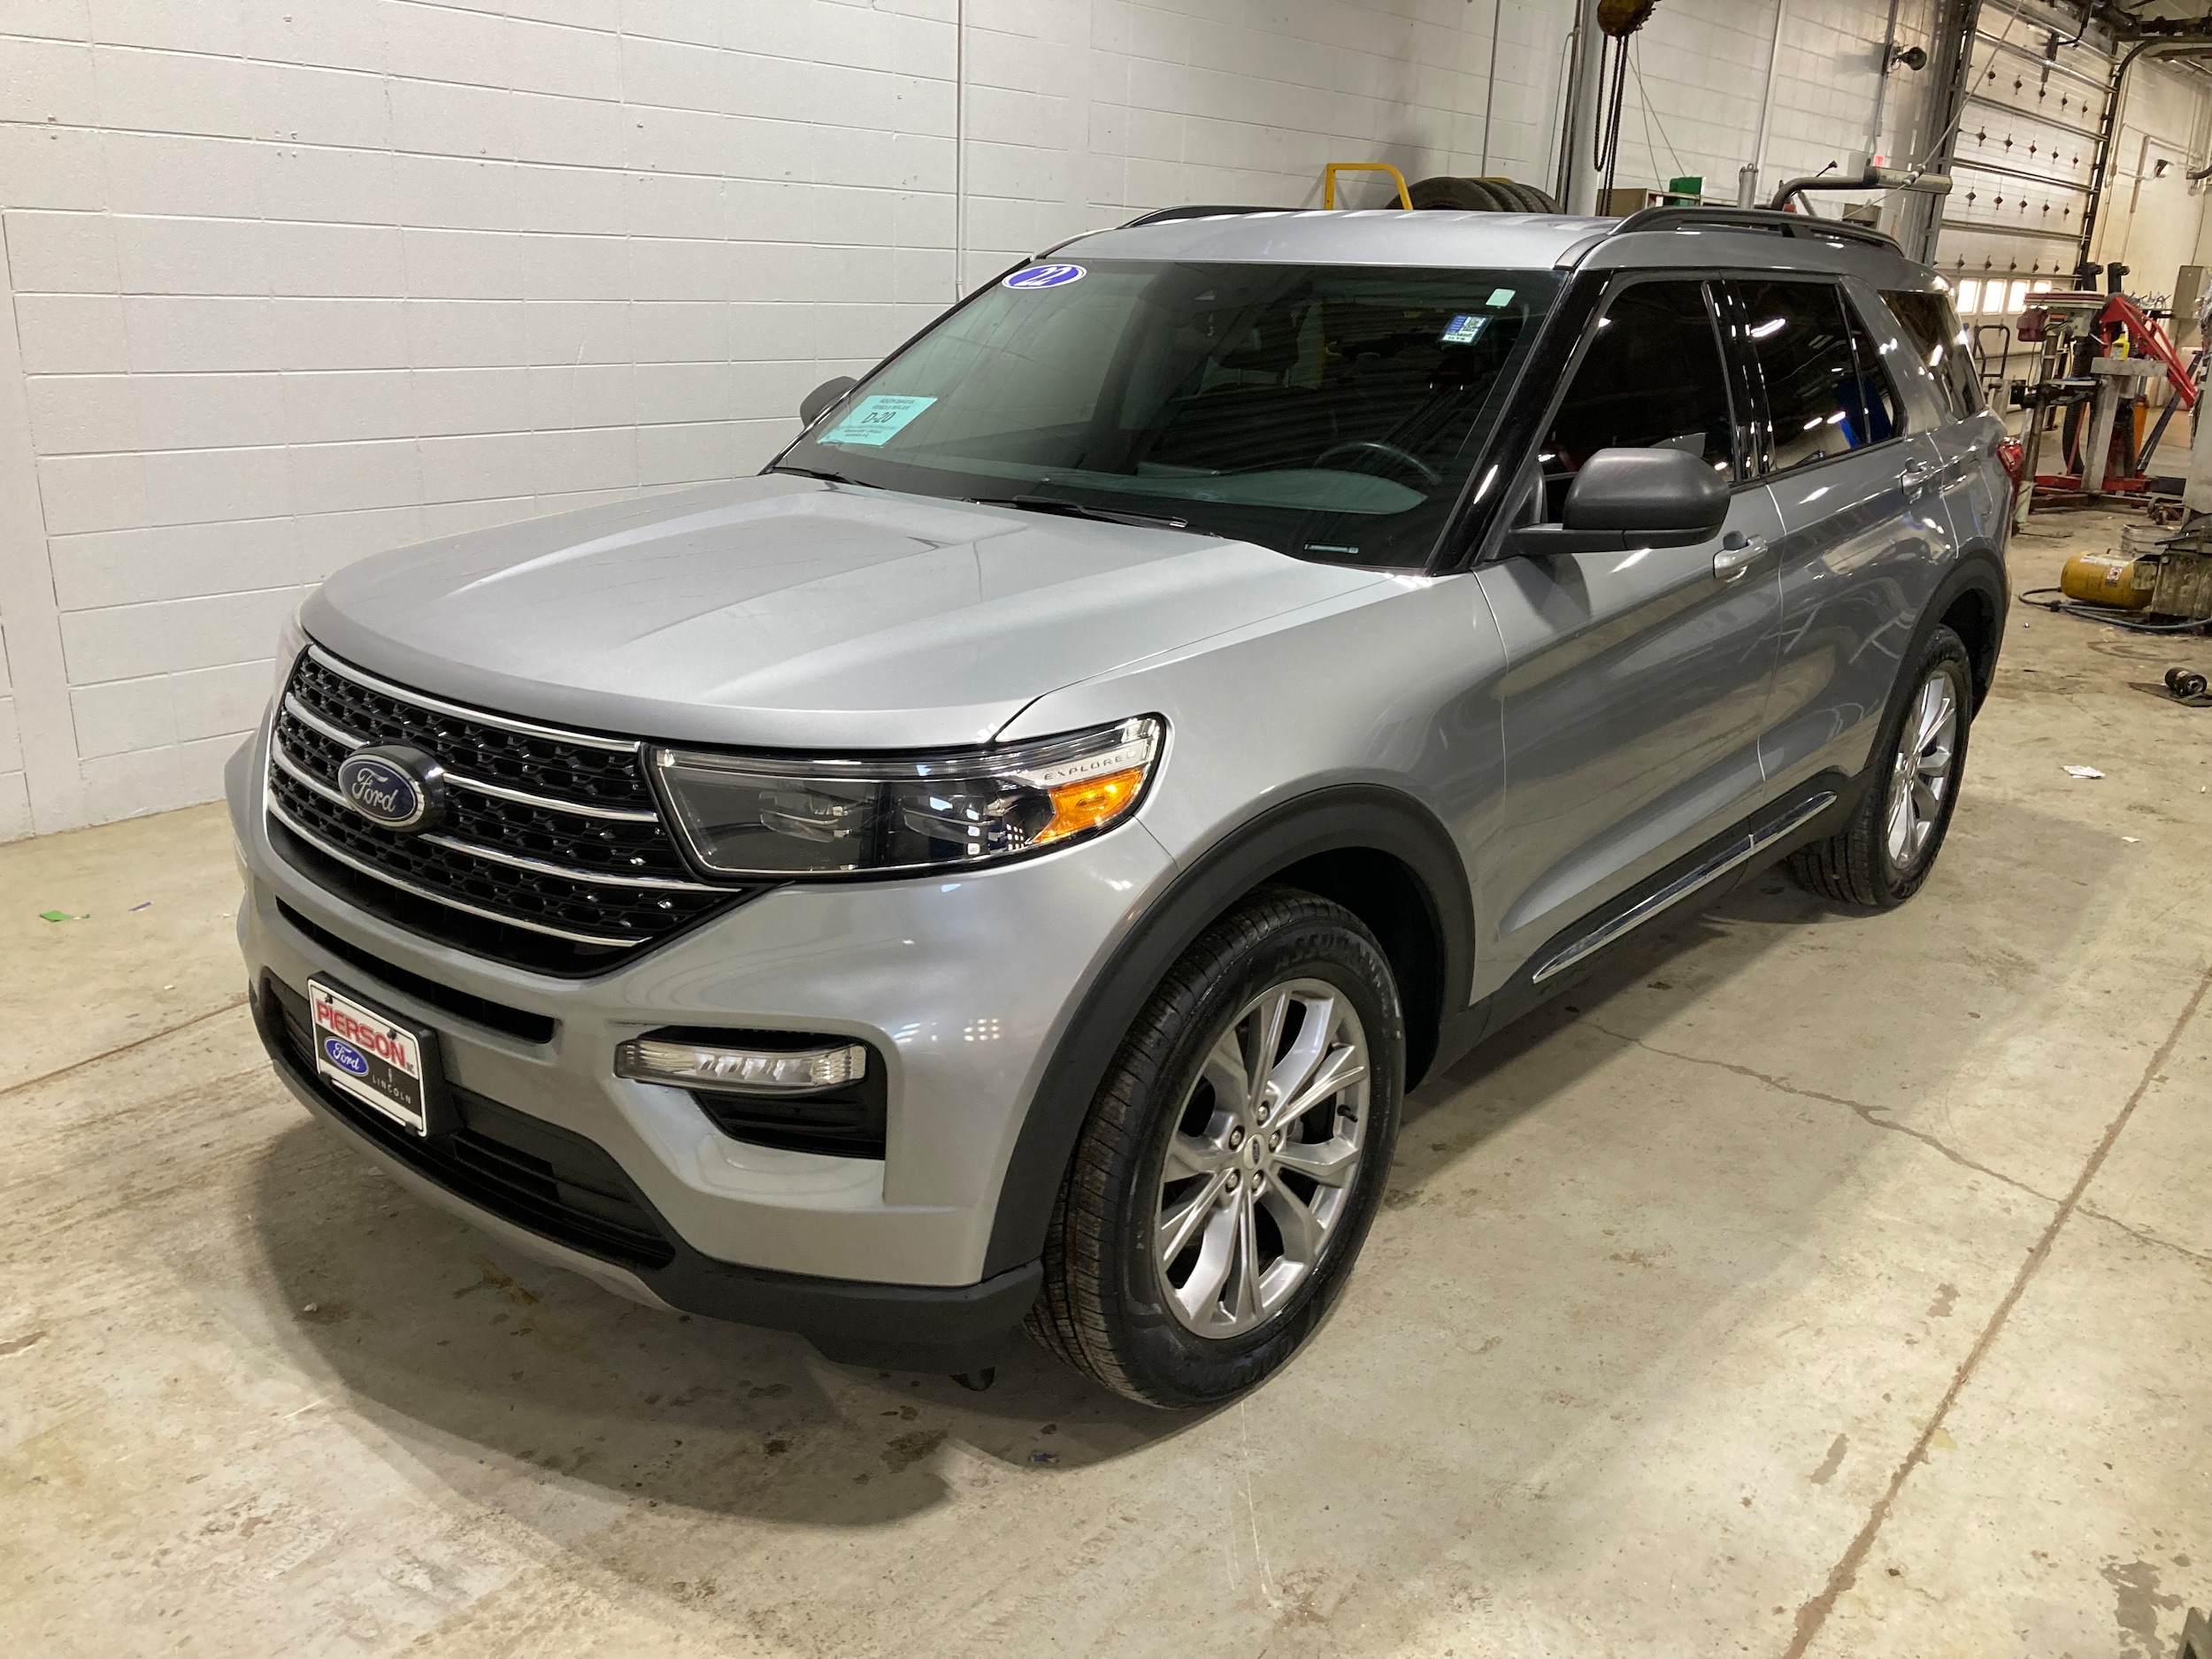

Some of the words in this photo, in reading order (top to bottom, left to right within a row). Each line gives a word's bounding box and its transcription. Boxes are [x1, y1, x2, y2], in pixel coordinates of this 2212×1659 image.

[1014, 266, 1071, 286] 22
[861, 411, 896, 423] D-20
[1044, 750, 1136, 780] EXPLORE
[351, 768, 399, 812] Ford
[316, 999, 405, 1068] PIERSON
[333, 1042, 360, 1071] Ford
[373, 1074, 411, 1104] LINCOLN
